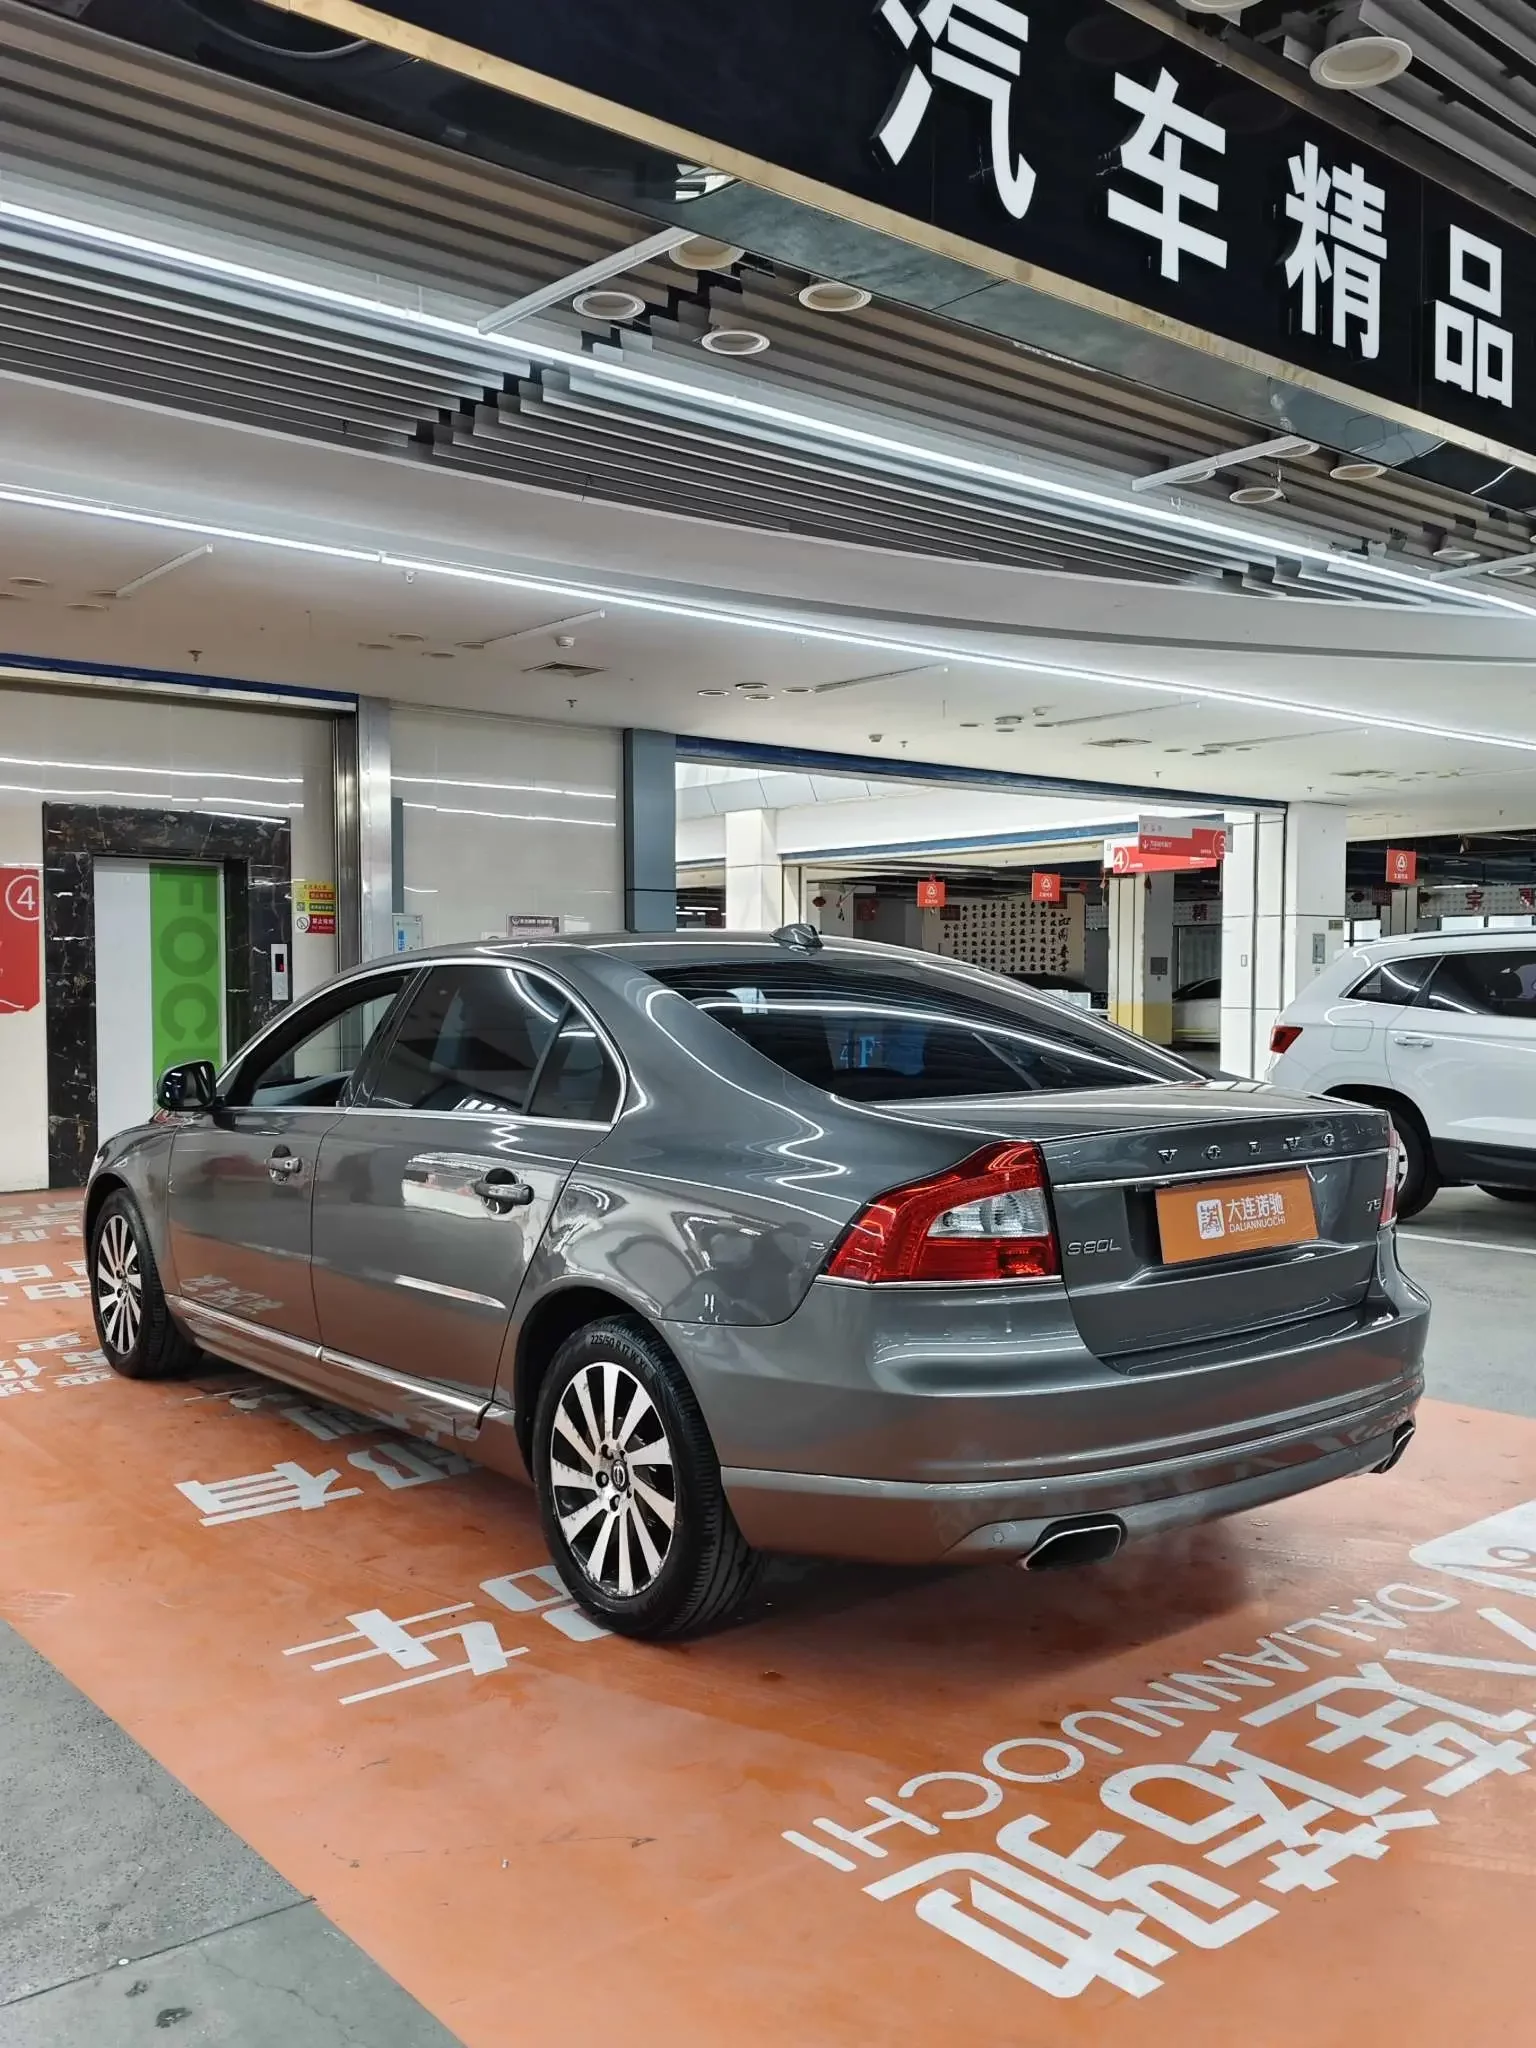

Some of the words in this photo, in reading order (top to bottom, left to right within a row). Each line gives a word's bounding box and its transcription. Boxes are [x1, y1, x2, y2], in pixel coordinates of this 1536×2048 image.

[872, 0, 1513, 408] 汽车精品
[1157, 1132, 1335, 1164] VOLVO
[1225, 1192, 1285, 1222] 大连诺驰
[1229, 1216, 1286, 1233] DALIANNUOCHI
[1066, 1238, 1122, 1256] S80L
[781, 1583, 1461, 1872] DALIANNUOCHI
